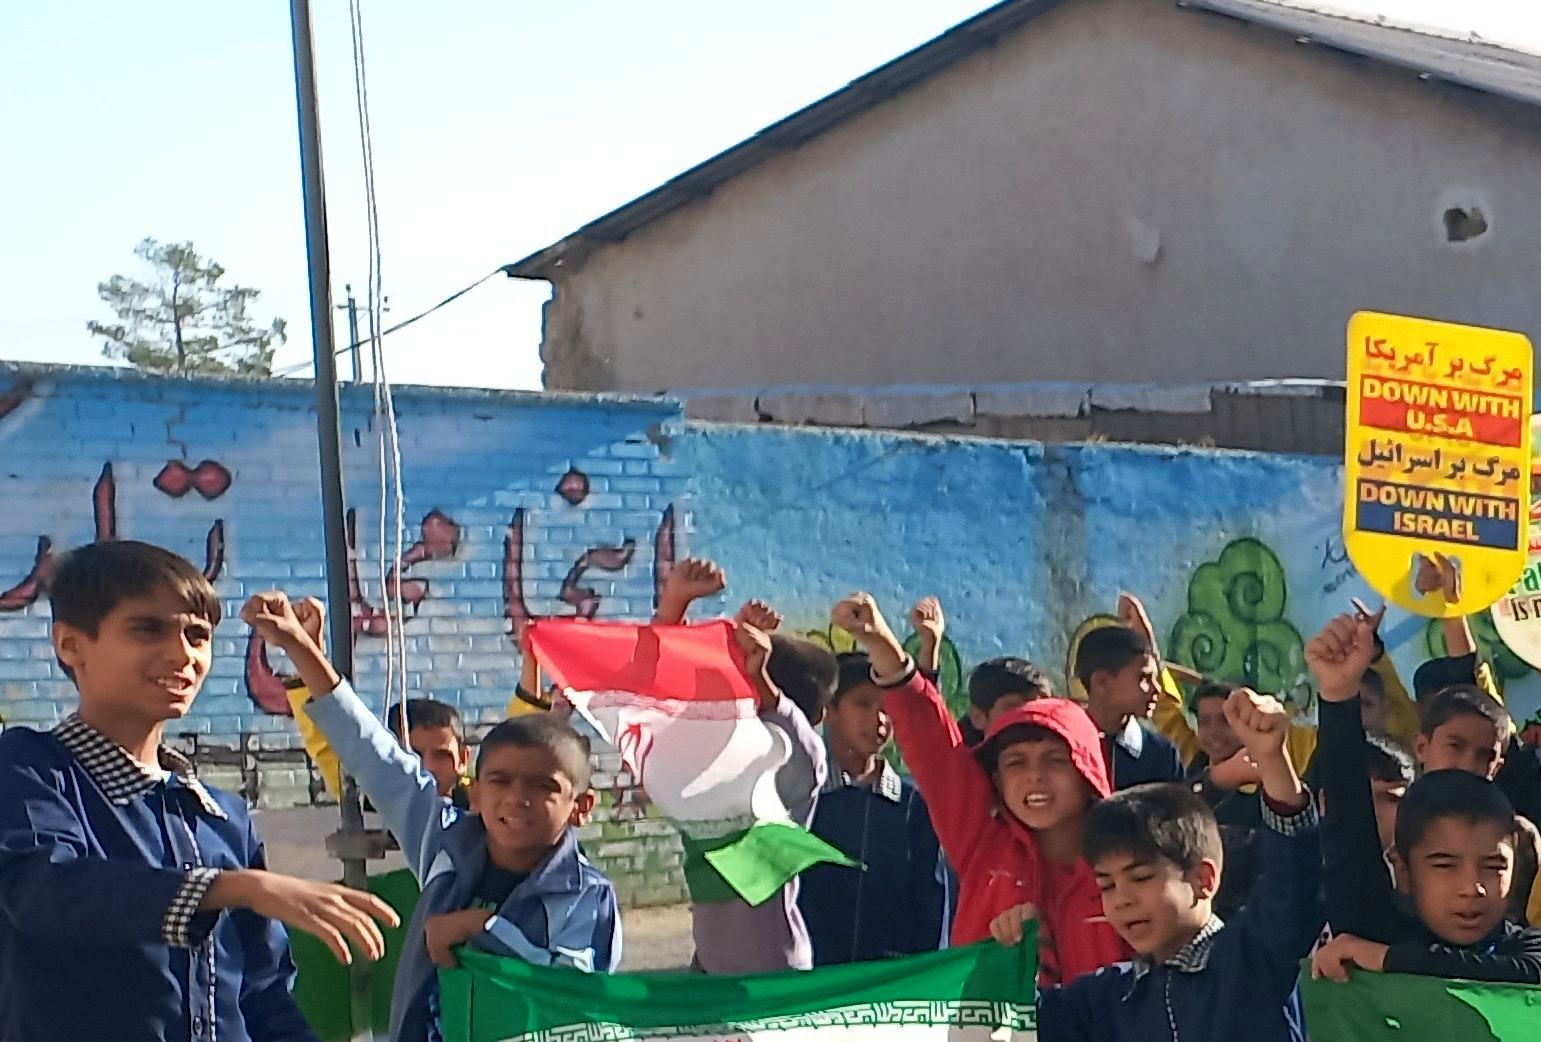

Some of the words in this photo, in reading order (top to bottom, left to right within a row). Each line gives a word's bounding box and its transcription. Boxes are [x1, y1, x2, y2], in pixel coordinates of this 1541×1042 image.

[1365, 336, 1438, 368] آمریکا
[1446, 355, 1464, 378] بر
[1470, 355, 1522, 385] مرگ
[1362, 378, 1448, 409] DOWN
[1452, 390, 1520, 418] WITH
[1358, 439, 1441, 474] اسرائیل
[1447, 455, 1465, 479] بر
[1359, 482, 1444, 511] DOWN
[1449, 494, 1516, 521] WITH
[1393, 512, 1480, 542] ISRAEL
